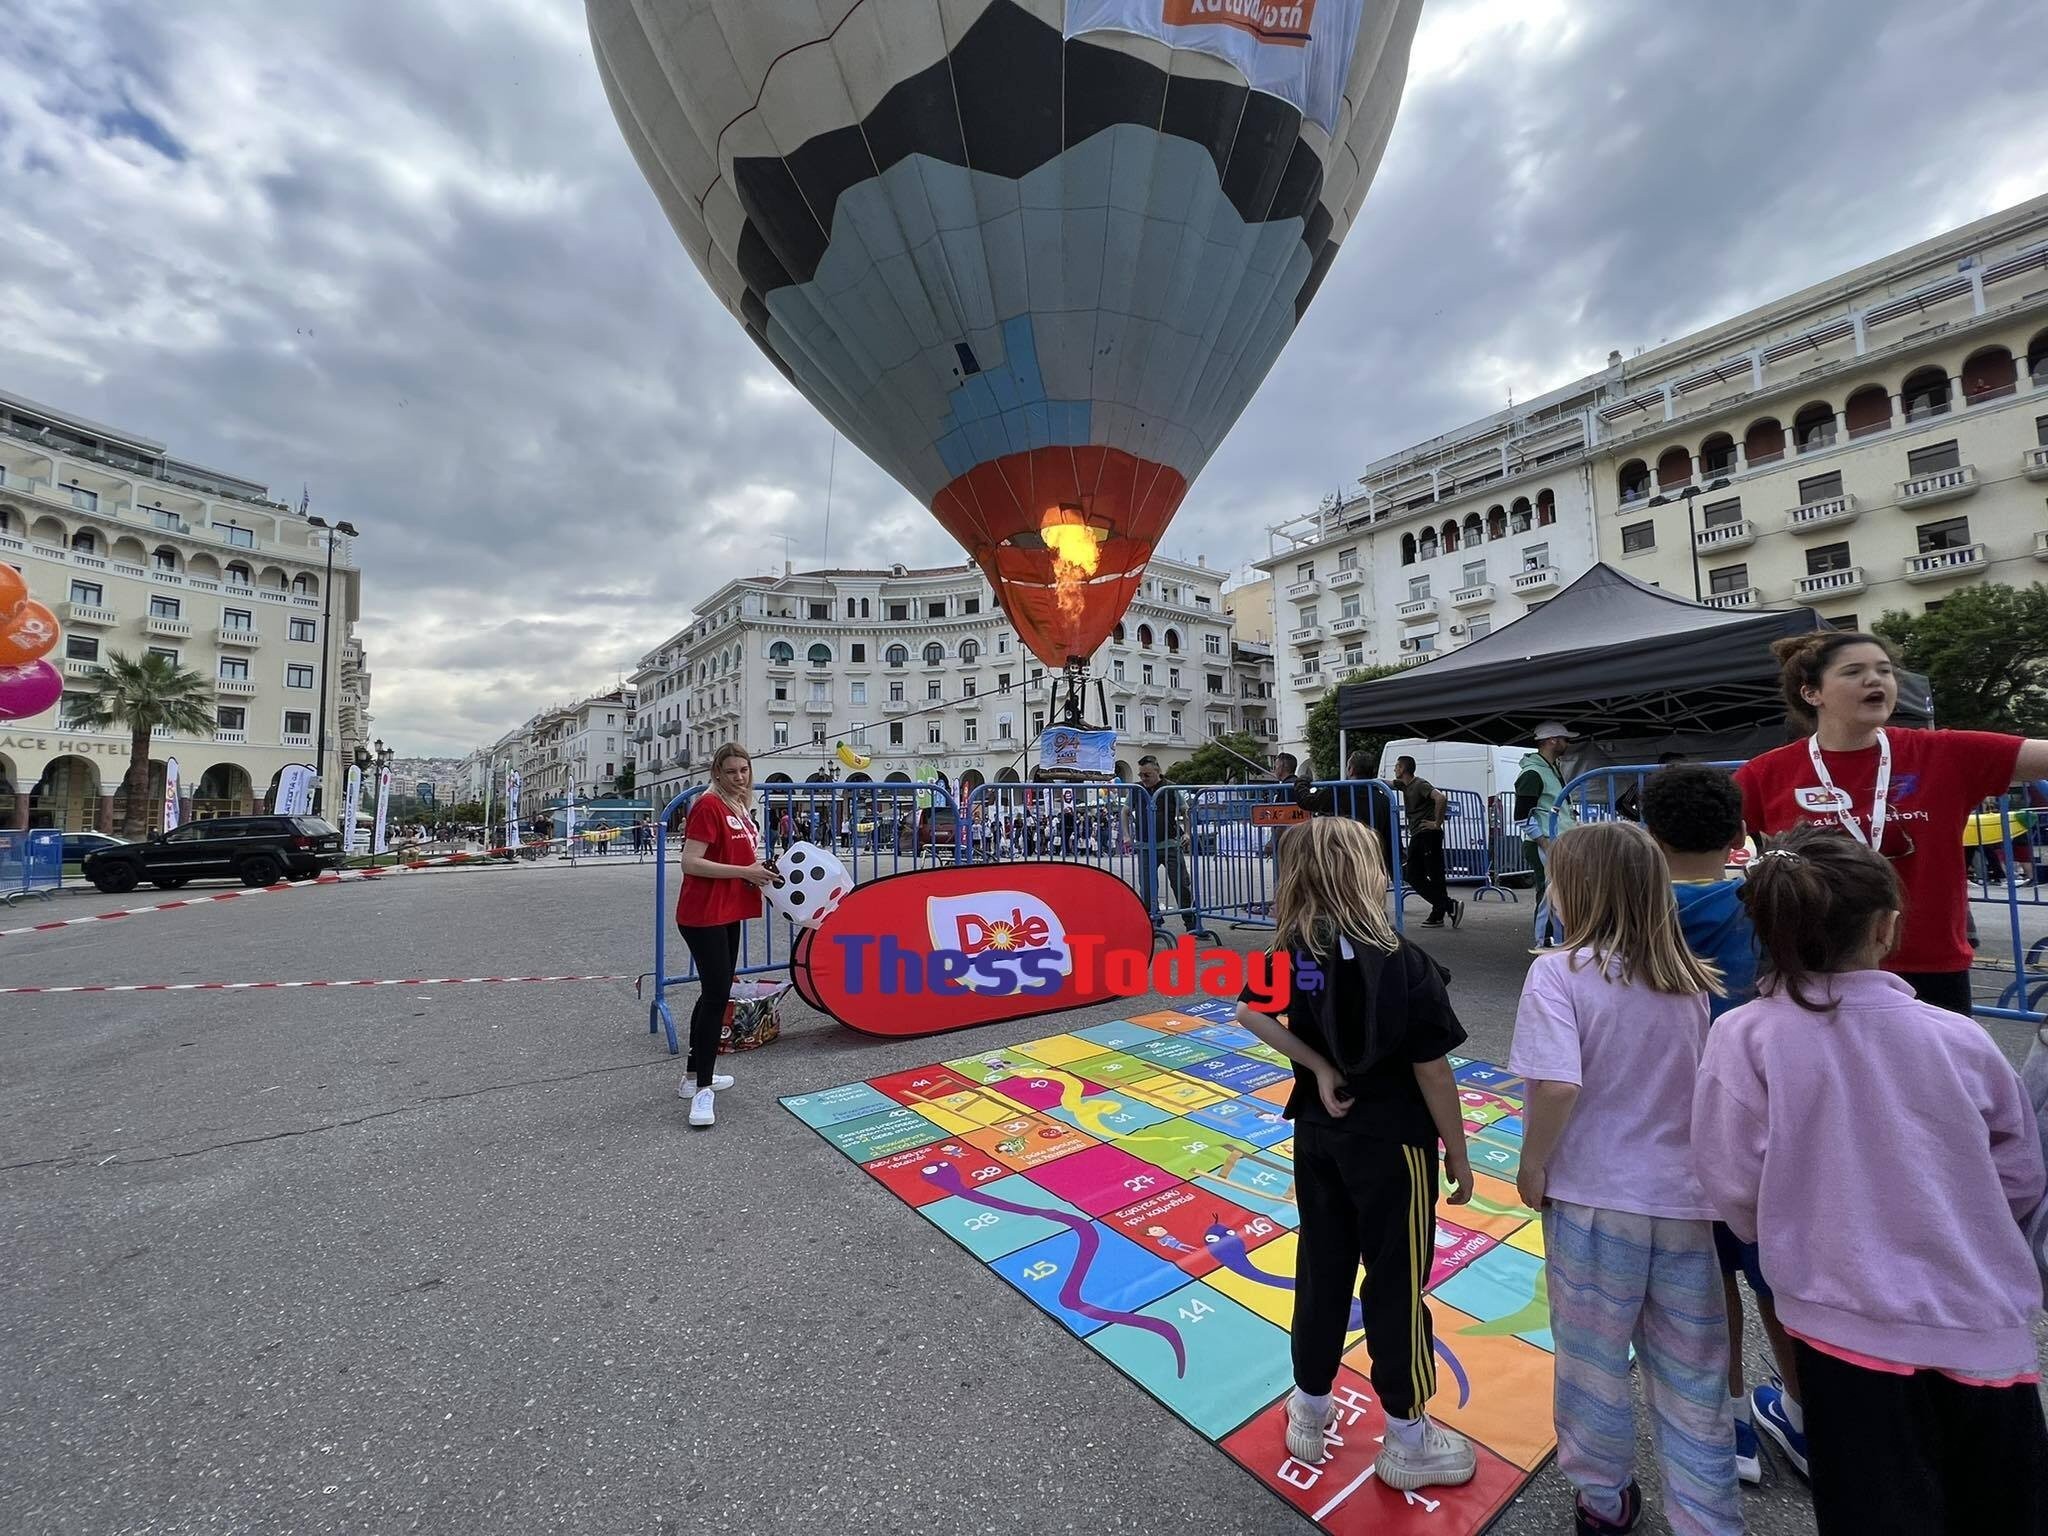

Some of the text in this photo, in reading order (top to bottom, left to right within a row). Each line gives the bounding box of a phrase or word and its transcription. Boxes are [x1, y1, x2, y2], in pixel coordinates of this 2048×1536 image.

[58, 740, 131, 755] HOTEL
[955, 907, 1050, 955] Dole
[1003, 1121, 1030, 1133] 30
[1484, 1150, 1511, 1164] 10
[1123, 1174, 1156, 1193] 27
[1250, 1171, 1279, 1186] 17
[963, 1212, 1001, 1232] 28
[1243, 1217, 1274, 1238] 16
[1023, 1261, 1058, 1281] 15
[1177, 1298, 1216, 1324] 14
